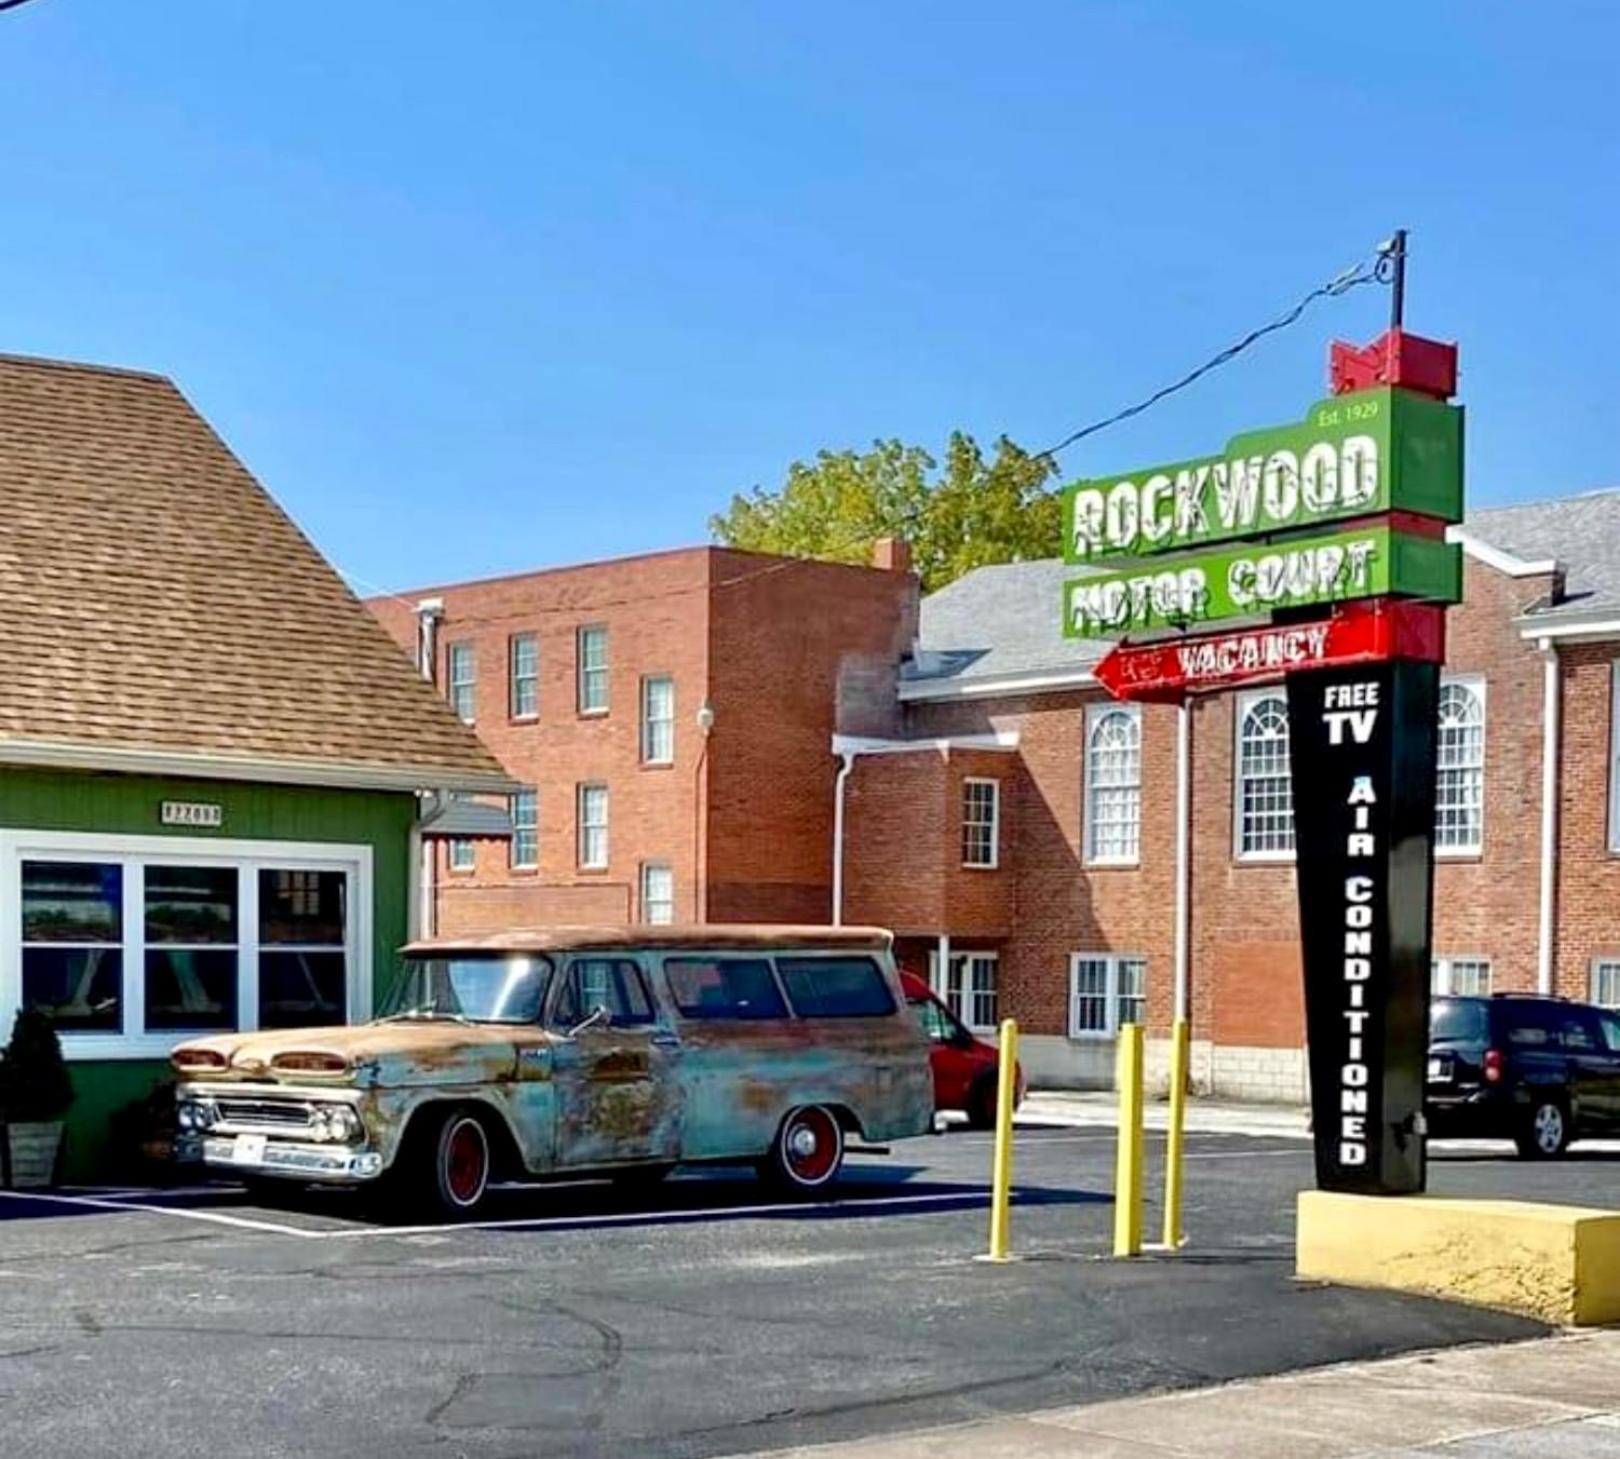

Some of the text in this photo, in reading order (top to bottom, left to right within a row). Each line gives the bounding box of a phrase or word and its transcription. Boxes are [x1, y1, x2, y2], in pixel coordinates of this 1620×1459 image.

[1346, 401, 1378, 420] 1929
[1073, 435, 1378, 555] ROCKWOOD
[1071, 540, 1376, 629] MOTOR COURT
[1177, 627, 1329, 679] VACANCY
[1324, 682, 1380, 708] FREE
[1322, 709, 1377, 745] TV
[1339, 776, 1377, 1166] AIR CONDITIONED
